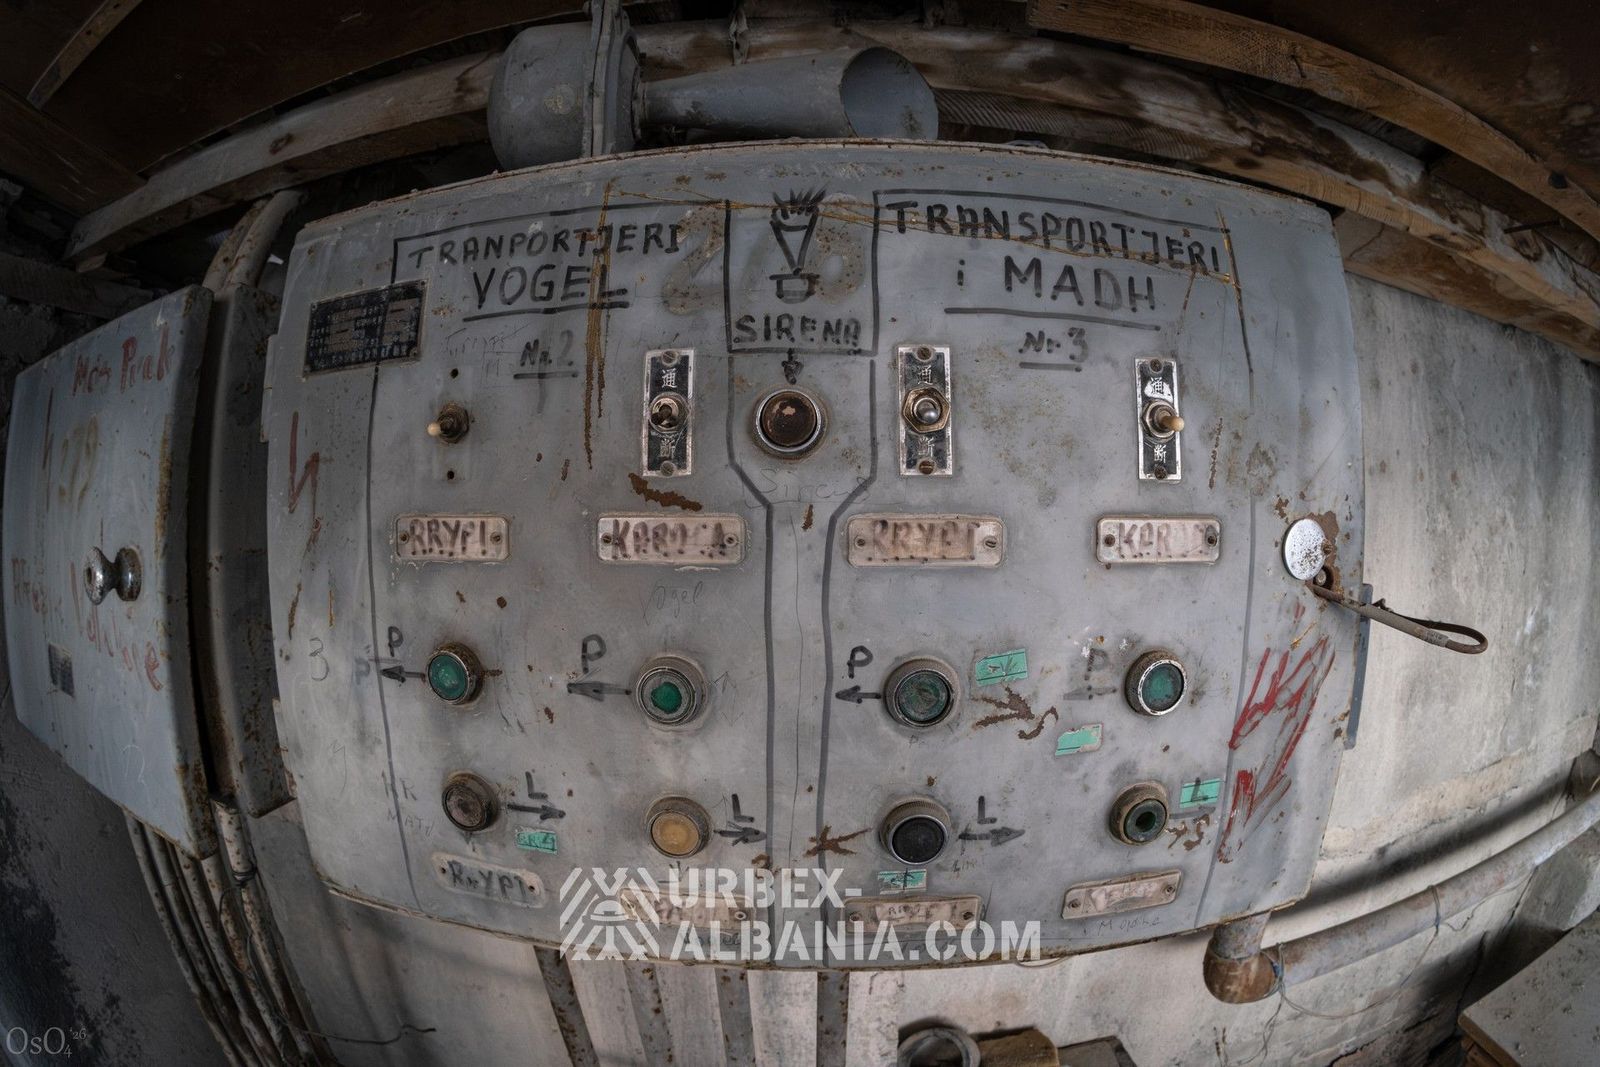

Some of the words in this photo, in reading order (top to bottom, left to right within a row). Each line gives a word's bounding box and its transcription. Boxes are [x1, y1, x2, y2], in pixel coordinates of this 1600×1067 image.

[886, 200, 1219, 275] TRANSPORTJERI
[473, 264, 628, 309] VOGEL
[1004, 255, 1156, 312] MADH
[733, 313, 862, 345] SIRENA
[388, 626, 404, 657] P
[581, 634, 607, 673] P
[847, 645, 873, 678] P
[525, 771, 549, 799] L
[731, 793, 755, 823] L
[977, 795, 997, 824] L
